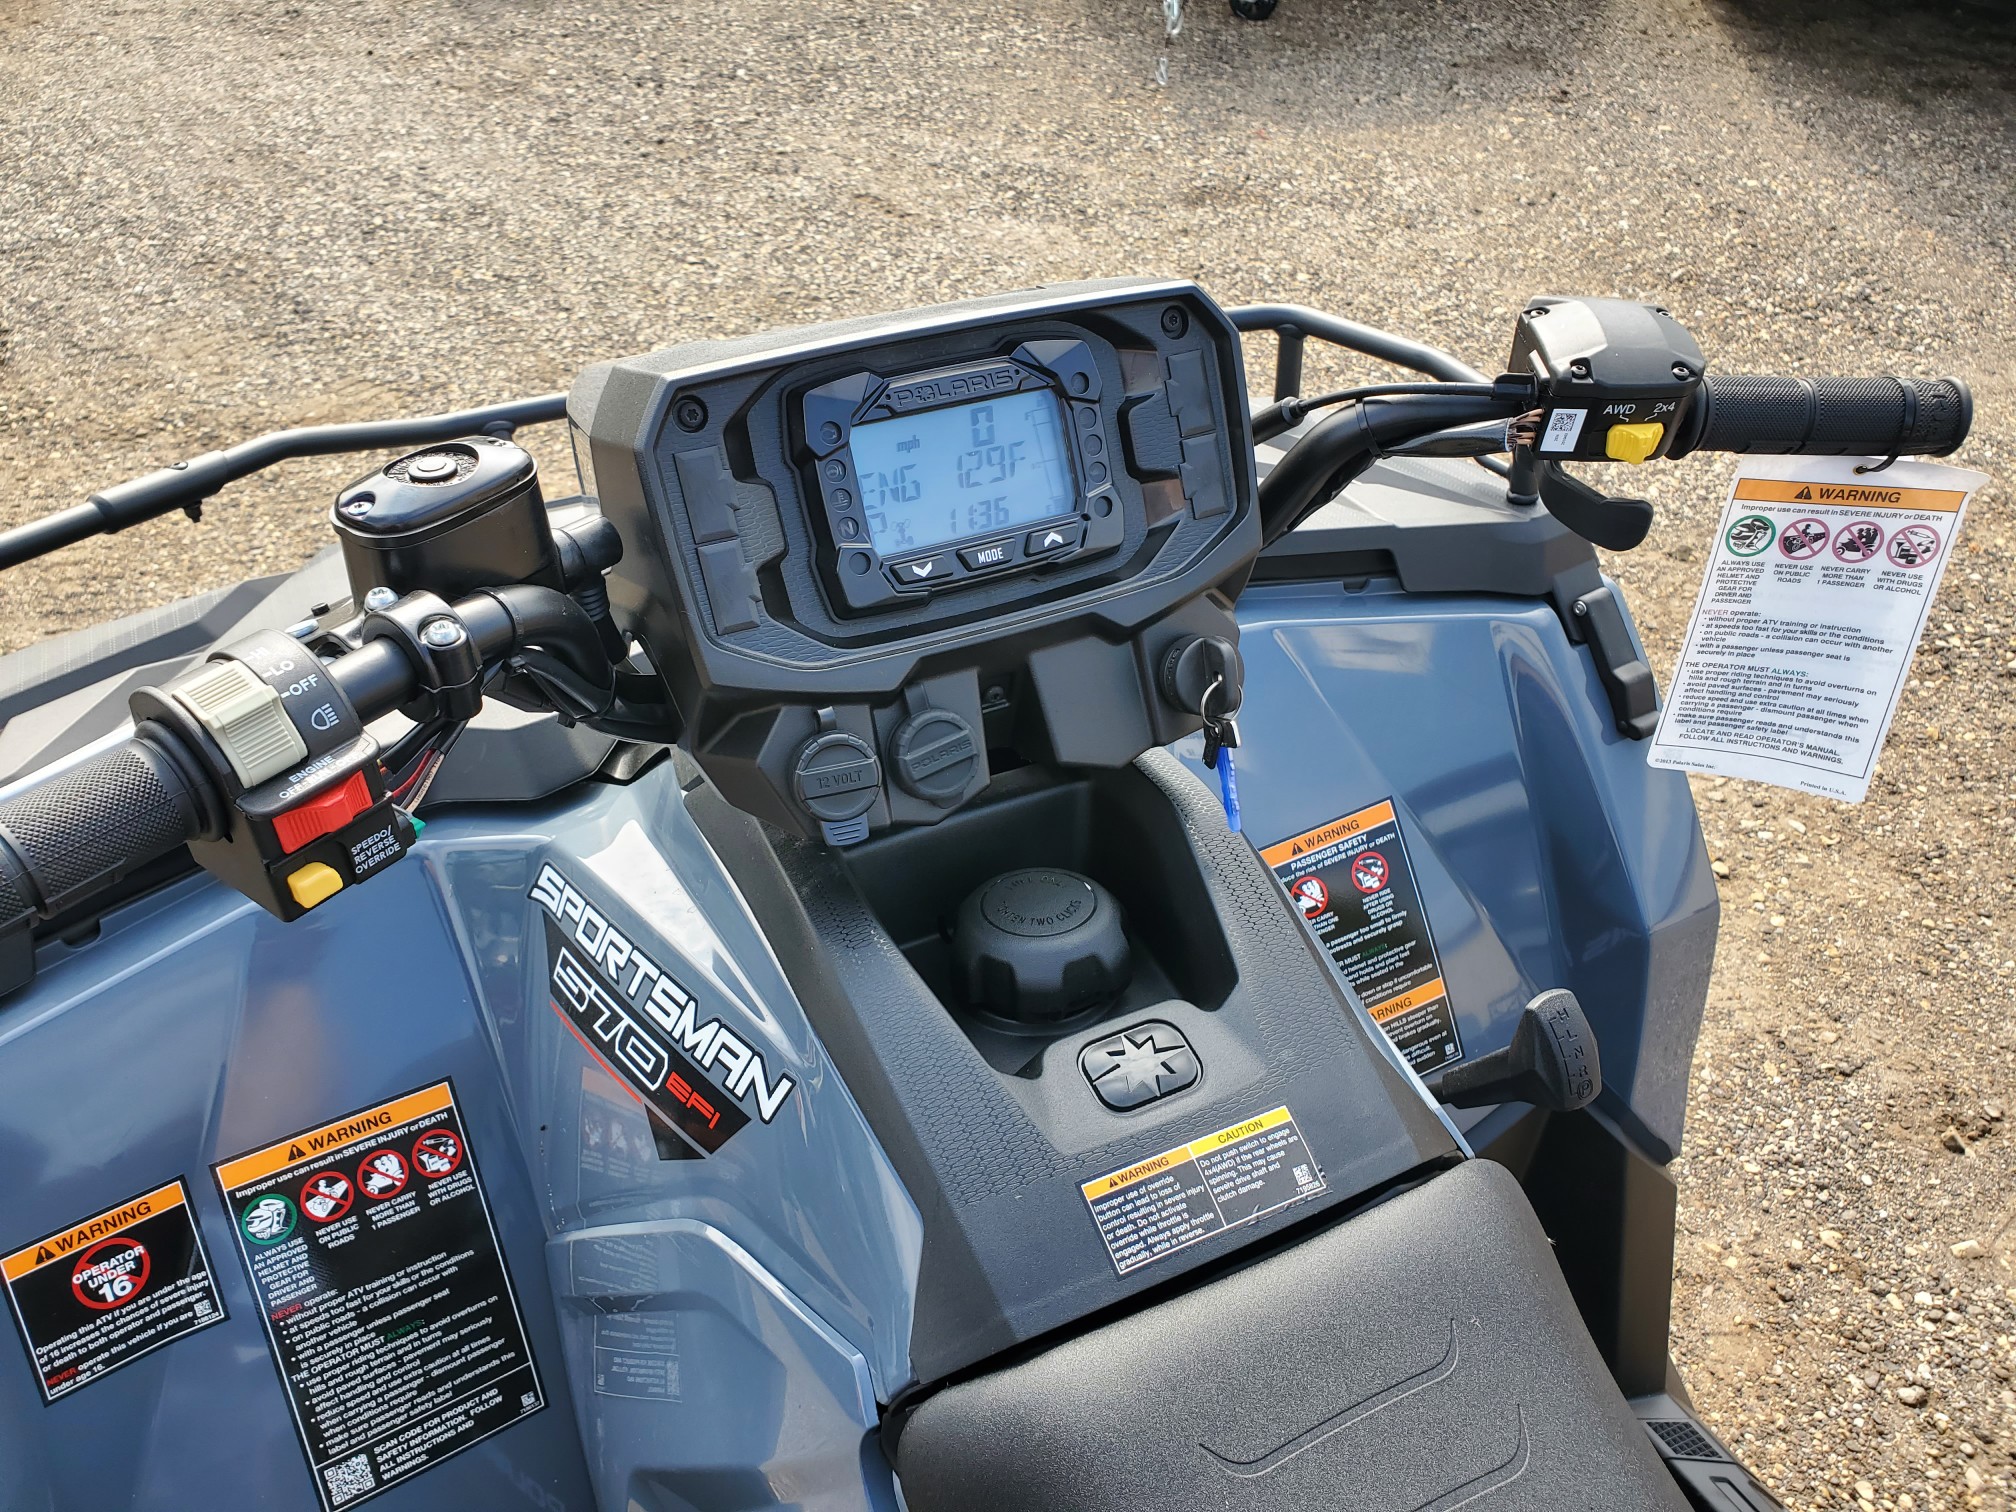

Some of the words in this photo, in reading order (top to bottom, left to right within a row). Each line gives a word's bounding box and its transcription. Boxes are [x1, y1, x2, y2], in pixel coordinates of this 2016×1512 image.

[895, 370, 1013, 407] POLARIS
[1603, 404, 1636, 415] AWD
[1653, 402, 1676, 413] 2x4
[970, 405, 995, 447] 0
[897, 435, 920, 453] mph
[1820, 488, 1900, 502] WARNING
[1741, 504, 1776, 512] Improper
[1839, 509, 1871, 517] SEVERE
[977, 547, 1003, 565] MODE
[289, 673, 318, 696] OFF
[911, 740, 973, 773] POLARIS
[1726, 738, 1780, 750] INSTRUCTIONS
[1782, 746, 1798, 754] AND
[1800, 750, 1842, 763] WARNINGS.
[288, 755, 335, 784] ENGINE
[816, 776, 830, 790] 12
[833, 770, 863, 787] VOLT
[351, 825, 391, 855] SPEEDO/
[1305, 820, 1360, 848] WARNING
[354, 835, 396, 864] REVERSE
[355, 842, 401, 873] OVERRIDE
[1291, 844, 1338, 871] PASSENGER
[1338, 834, 1367, 851] SAFETY
[1306, 866, 1316, 874] risk
[1324, 855, 1346, 867] SEVERE
[1347, 845, 1368, 857] INJURY
[1376, 832, 1395, 846] DEATH
[1362, 892, 1378, 903] NEVER
[1363, 900, 1379, 910] AFTER
[1368, 905, 1384, 915] DRUGS
[1371, 908, 1394, 920] ALCOHOL
[529, 862, 795, 1123] SPORTSMAN
[553, 946, 668, 1091] 570
[665, 1070, 721, 1129] EFI
[308, 1112, 391, 1150] WARNING
[1218, 1120, 1263, 1143] CAUTION
[235, 1178, 275, 1198] Improper
[276, 1172, 292, 1182] use
[293, 1166, 309, 1176] can
[310, 1155, 334, 1170] result
[343, 1138, 376, 1156] SEVERE
[377, 1126, 408, 1143] INJURY
[418, 1112, 447, 1128] DEATH
[1199, 1159, 1210, 1167] Do
[1210, 1154, 1222, 1163] not
[1222, 1148, 1238, 1160] push
[1238, 1139, 1259, 1152] switch
[1267, 1128, 1290, 1140] engage
[1240, 1153, 1252, 1161] the
[1252, 1147, 1264, 1156] rear
[1265, 1139, 1287, 1151] wheels
[428, 1176, 452, 1189] NEVER
[452, 1170, 467, 1180] USE
[1117, 1157, 1169, 1182] WARNING
[1208, 1170, 1237, 1185] spinning.
[1237, 1163, 1252, 1172] This
[1252, 1158, 1266, 1167] may
[1266, 1150, 1285, 1161] cause
[1212, 1181, 1234, 1194] severe
[1234, 1174, 1251, 1184] drive
[1251, 1166, 1267, 1178] shaft
[1267, 1161, 1280, 1171] and
[428, 1187, 446, 1198] WITH
[447, 1177, 472, 1190] DRUGS
[429, 1197, 440, 1206] OR
[442, 1184, 475, 1201] ALCOHOL
[1217, 1190, 1237, 1202] clutch
[1237, 1180, 1265, 1194] damage.
[366, 1202, 390, 1215] NEVER
[391, 1191, 415, 1205] CARRY
[372, 1208, 394, 1221] MORE
[395, 1200, 415, 1211] THAN
[377, 1206, 420, 1227] PASSENGER
[56, 1202, 150, 1251] WARNING
[315, 1222, 340, 1236] NEVER
[341, 1216, 357, 1226] USE
[318, 1235, 330, 1243] ON
[331, 1224, 358, 1238] PUBLIC
[328, 1234, 354, 1248] ROADS
[72, 1246, 144, 1284] OPERATOR
[88, 1261, 135, 1288] UNDER
[99, 1275, 132, 1302] 16
[36, 1332, 77, 1354] Operating
[78, 1323, 94, 1334] this
[96, 1313, 112, 1326] ATV
[113, 1309, 120, 1317] if
[121, 1303, 136, 1315] you
[137, 1296, 151, 1306] are
[152, 1283, 175, 1298] under
[176, 1277, 190, 1286] the
[191, 1270, 206, 1280] age
[39, 1354, 48, 1364] of
[49, 1349, 60, 1358] 16
[60, 1330, 100, 1353] increases
[100, 1323, 114, 1333] the
[115, 1306, 149, 1326] chances
[150, 1300, 158, 1309] of
[160, 1289, 186, 1304] severe
[186, 1279, 208, 1292] injury
[42, 1364, 51, 1372] or
[53, 1352, 77, 1367] death
[88, 1336, 108, 1349] both
[109, 1318, 143, 1339] operator
[145, 1309, 160, 1321] and
[161, 1291, 205, 1314] passenger.
[46, 1368, 75, 1385] NEVER
[78, 1351, 109, 1370] operate
[110, 1343, 126, 1354] this
[127, 1328, 156, 1345] vehicle
[163, 1318, 179, 1329] you
[179, 1311, 193, 1320] are
[50, 1379, 73, 1394] under
[75, 1370, 91, 1382] age
[92, 1363, 105, 1372] 16.
